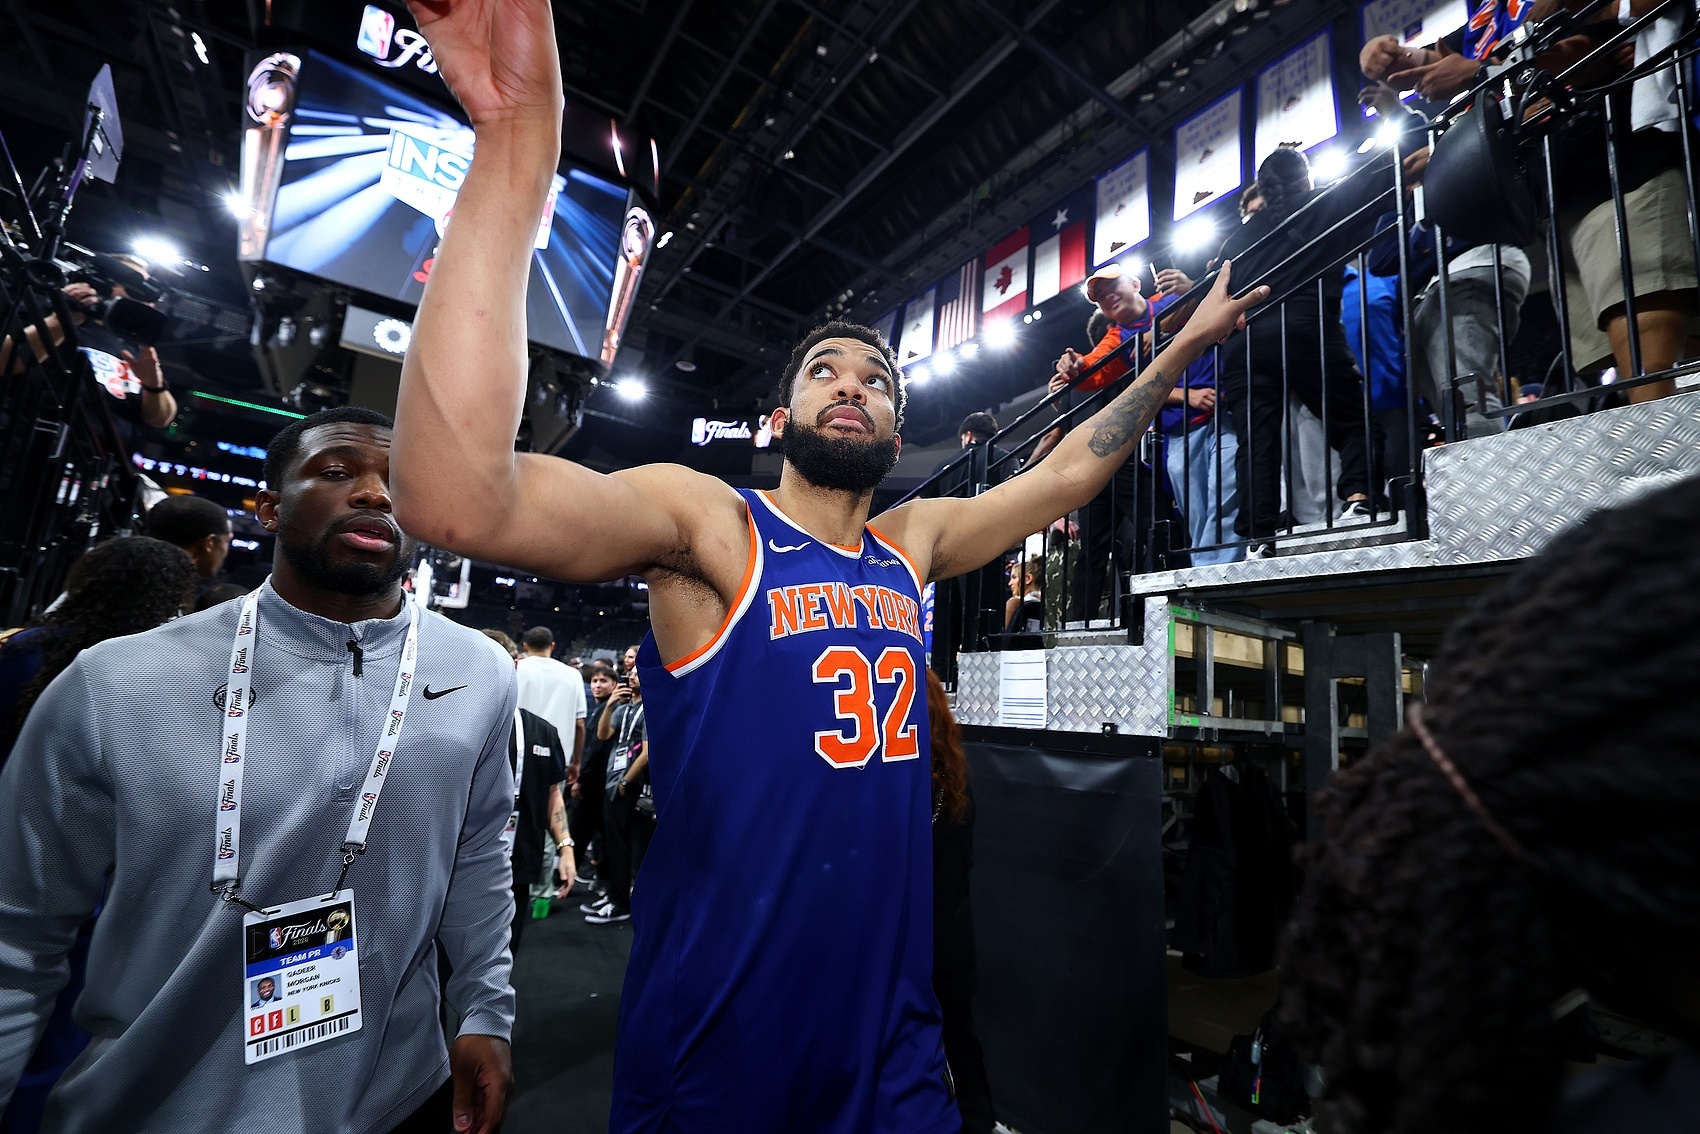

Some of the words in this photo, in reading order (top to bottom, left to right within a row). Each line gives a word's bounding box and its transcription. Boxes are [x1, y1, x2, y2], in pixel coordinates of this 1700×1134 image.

[698, 420, 752, 446] Finals
[766, 581, 857, 641] NEW
[852, 584, 924, 646] YORK
[234, 647, 249, 670] Finals
[229, 687, 245, 714] Finals
[811, 645, 920, 769] 32
[225, 732, 241, 760] Finals
[373, 751, 389, 778] Finals
[221, 779, 238, 807] Finals
[358, 794, 374, 821] Finals
[219, 827, 236, 854] Finals
[275, 919, 328, 950] Finals
[280, 952, 306, 966] TEAM
[308, 949, 321, 959] PR
[286, 974, 320, 988] MORGAN
[287, 988, 300, 996] NEW
[302, 983, 318, 993] YORK
[319, 977, 341, 987] KNICKS
[272, 1012, 279, 1028] F
[290, 1009, 297, 1022] L
[324, 999, 331, 1012] B
